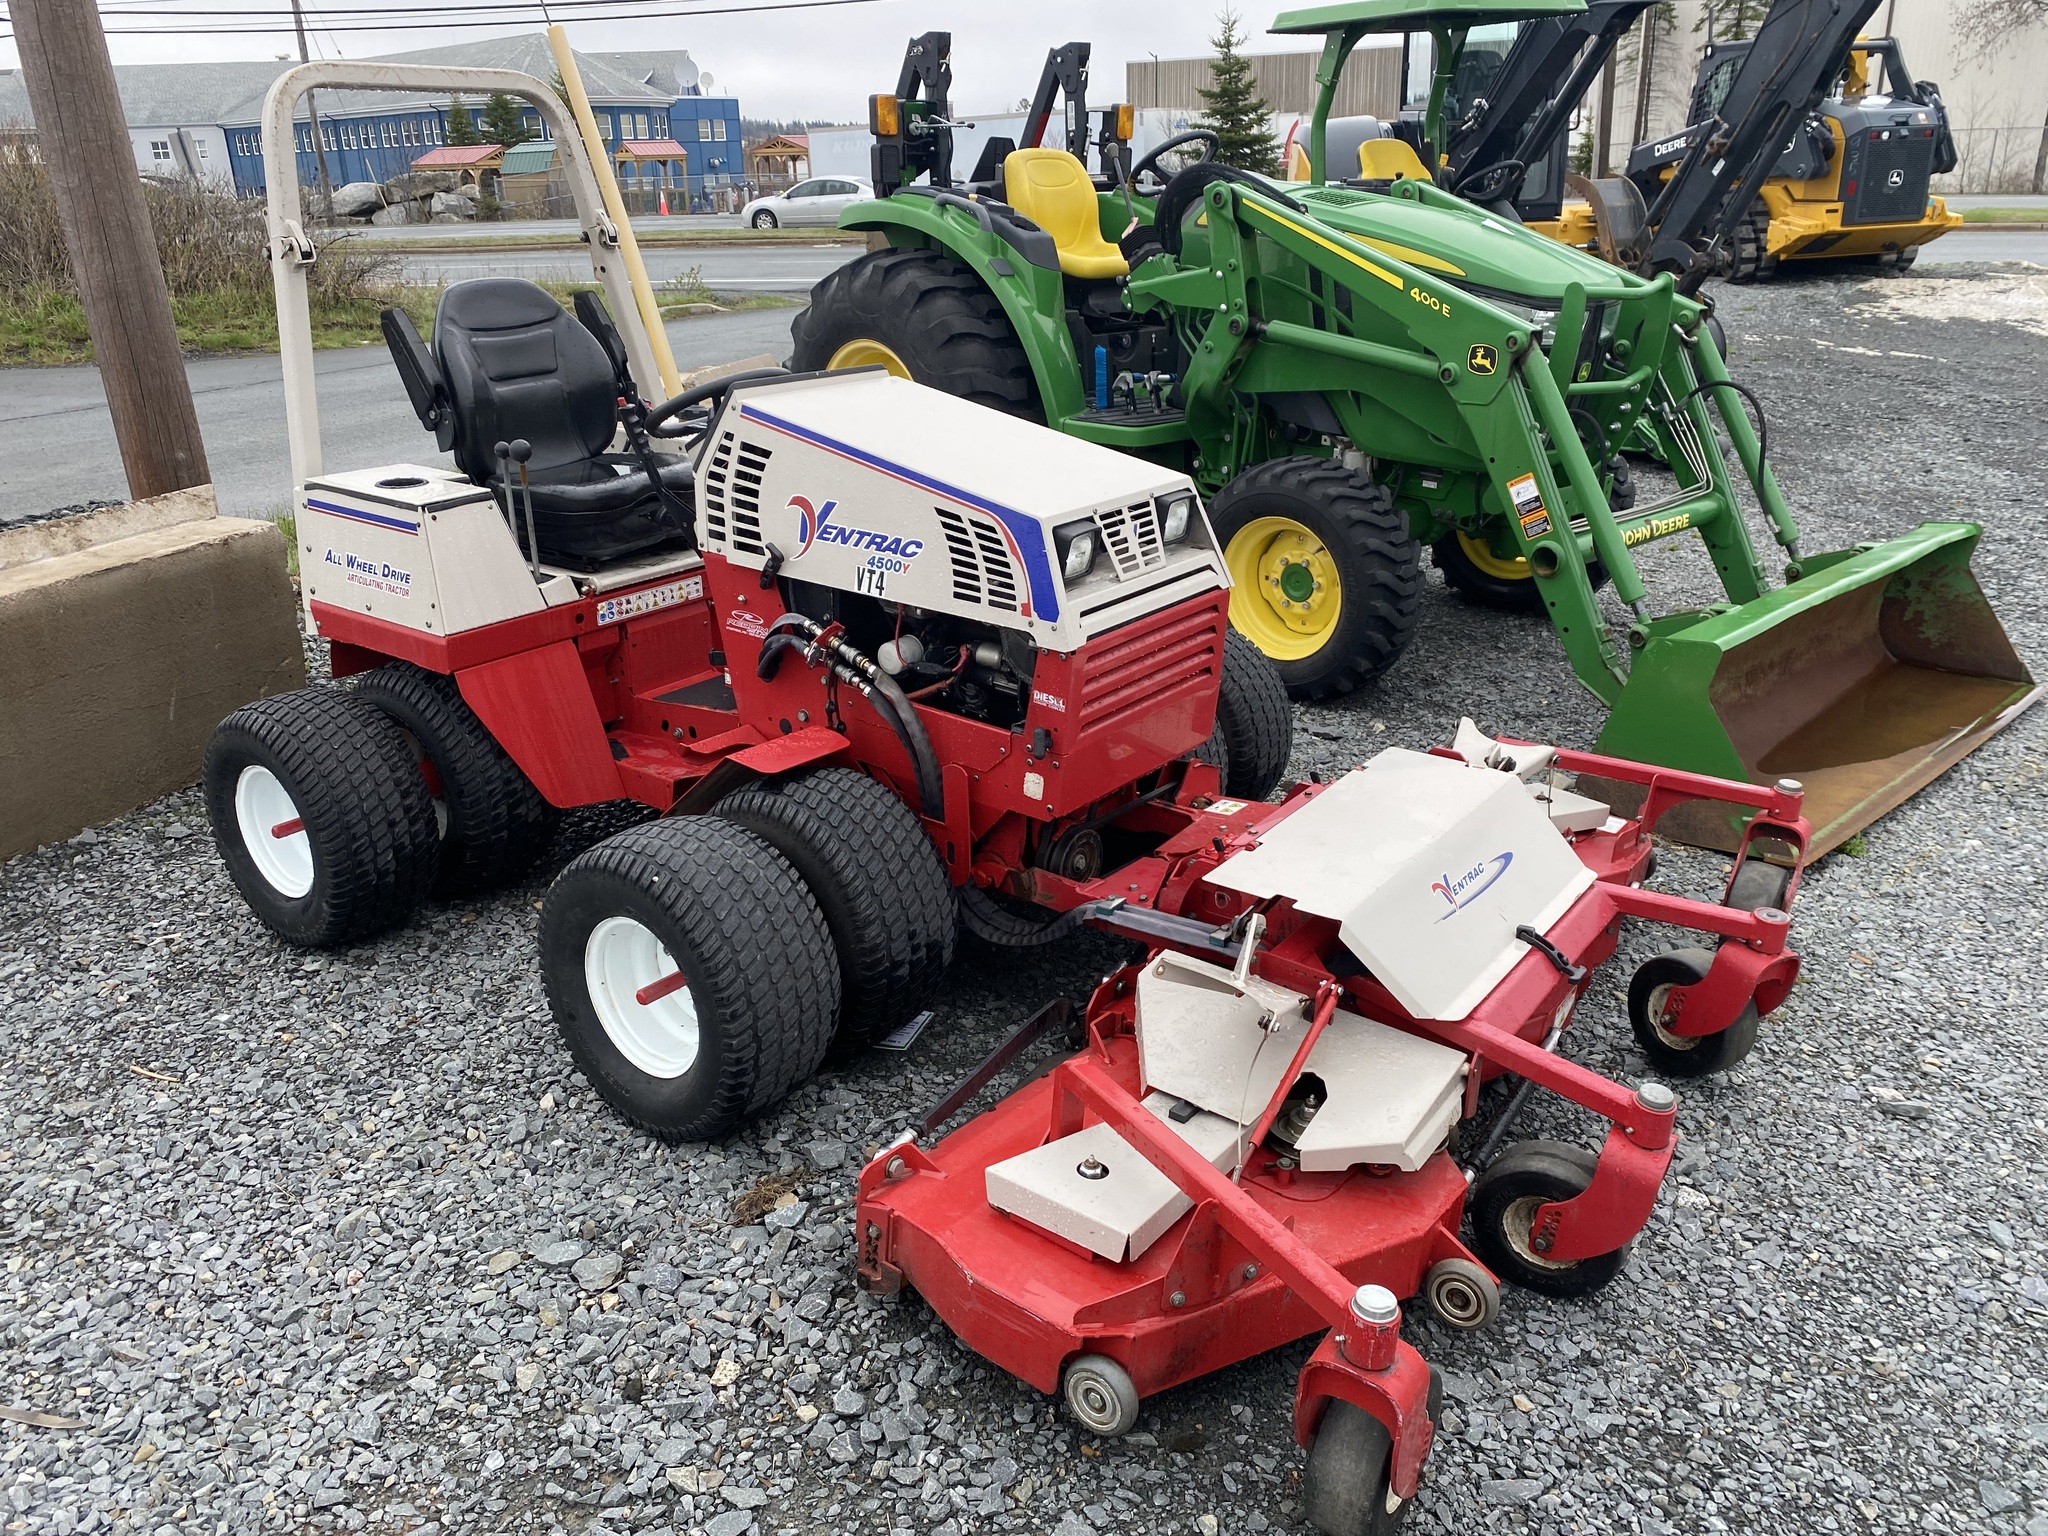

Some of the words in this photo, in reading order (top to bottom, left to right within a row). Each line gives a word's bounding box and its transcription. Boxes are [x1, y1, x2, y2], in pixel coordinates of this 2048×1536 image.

[1654, 136, 1687, 157] DEERE
[1410, 287, 1440, 312] 400
[1442, 303, 1451, 318] E
[785, 494, 925, 561] VENTRAC
[1651, 513, 1690, 537] DEERE
[867, 555, 911, 575] 4500Y
[347, 573, 384, 591] ARTICULATING
[385, 583, 410, 598] TRACTOR
[856, 566, 885, 597] VT4
[1431, 861, 1486, 914] VENTRAC
